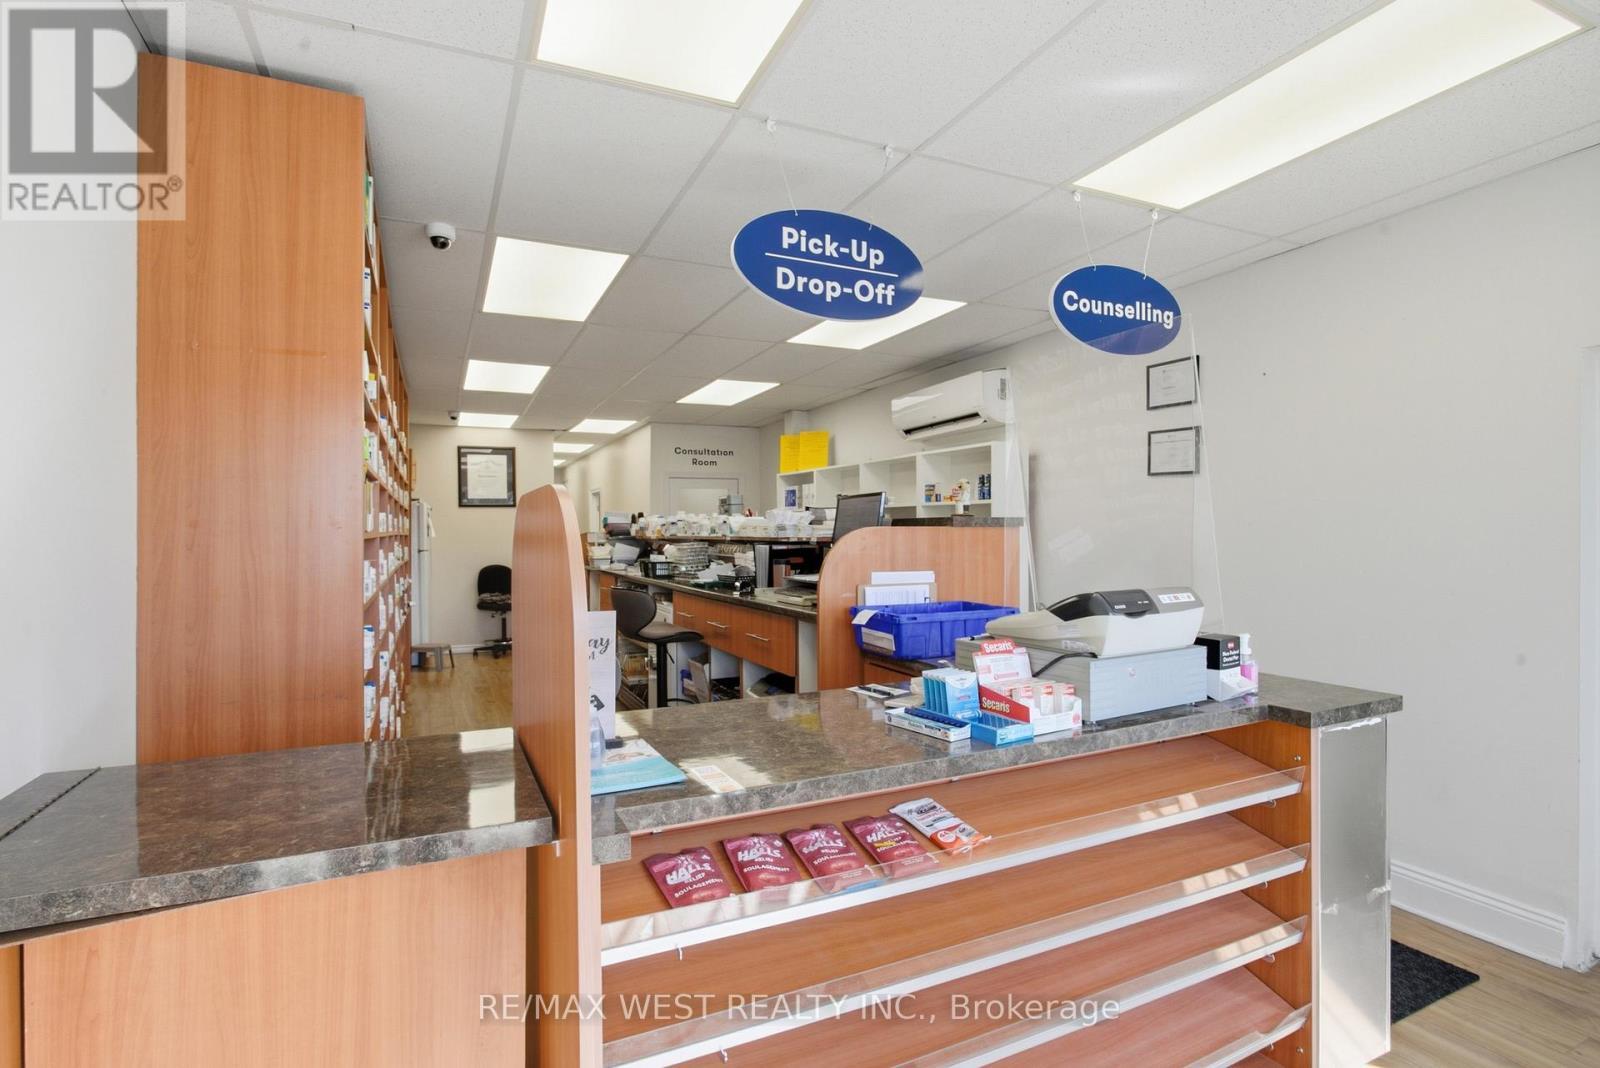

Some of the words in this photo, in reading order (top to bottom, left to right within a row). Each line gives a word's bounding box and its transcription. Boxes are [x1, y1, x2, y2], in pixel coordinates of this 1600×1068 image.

[782, 226, 885, 269] Pick-Up
[776, 266, 896, 306] Drop-Off
[1062, 290, 1174, 330] Counselling
[674, 446, 735, 456] Consultation
[691, 458, 718, 466] Room
[983, 640, 1013, 654] Secaris
[982, 697, 1011, 714] Secaris
[737, 846, 784, 863] HALLS
[665, 861, 714, 886] HALLS
[673, 878, 724, 899] SOULAGEMENT
